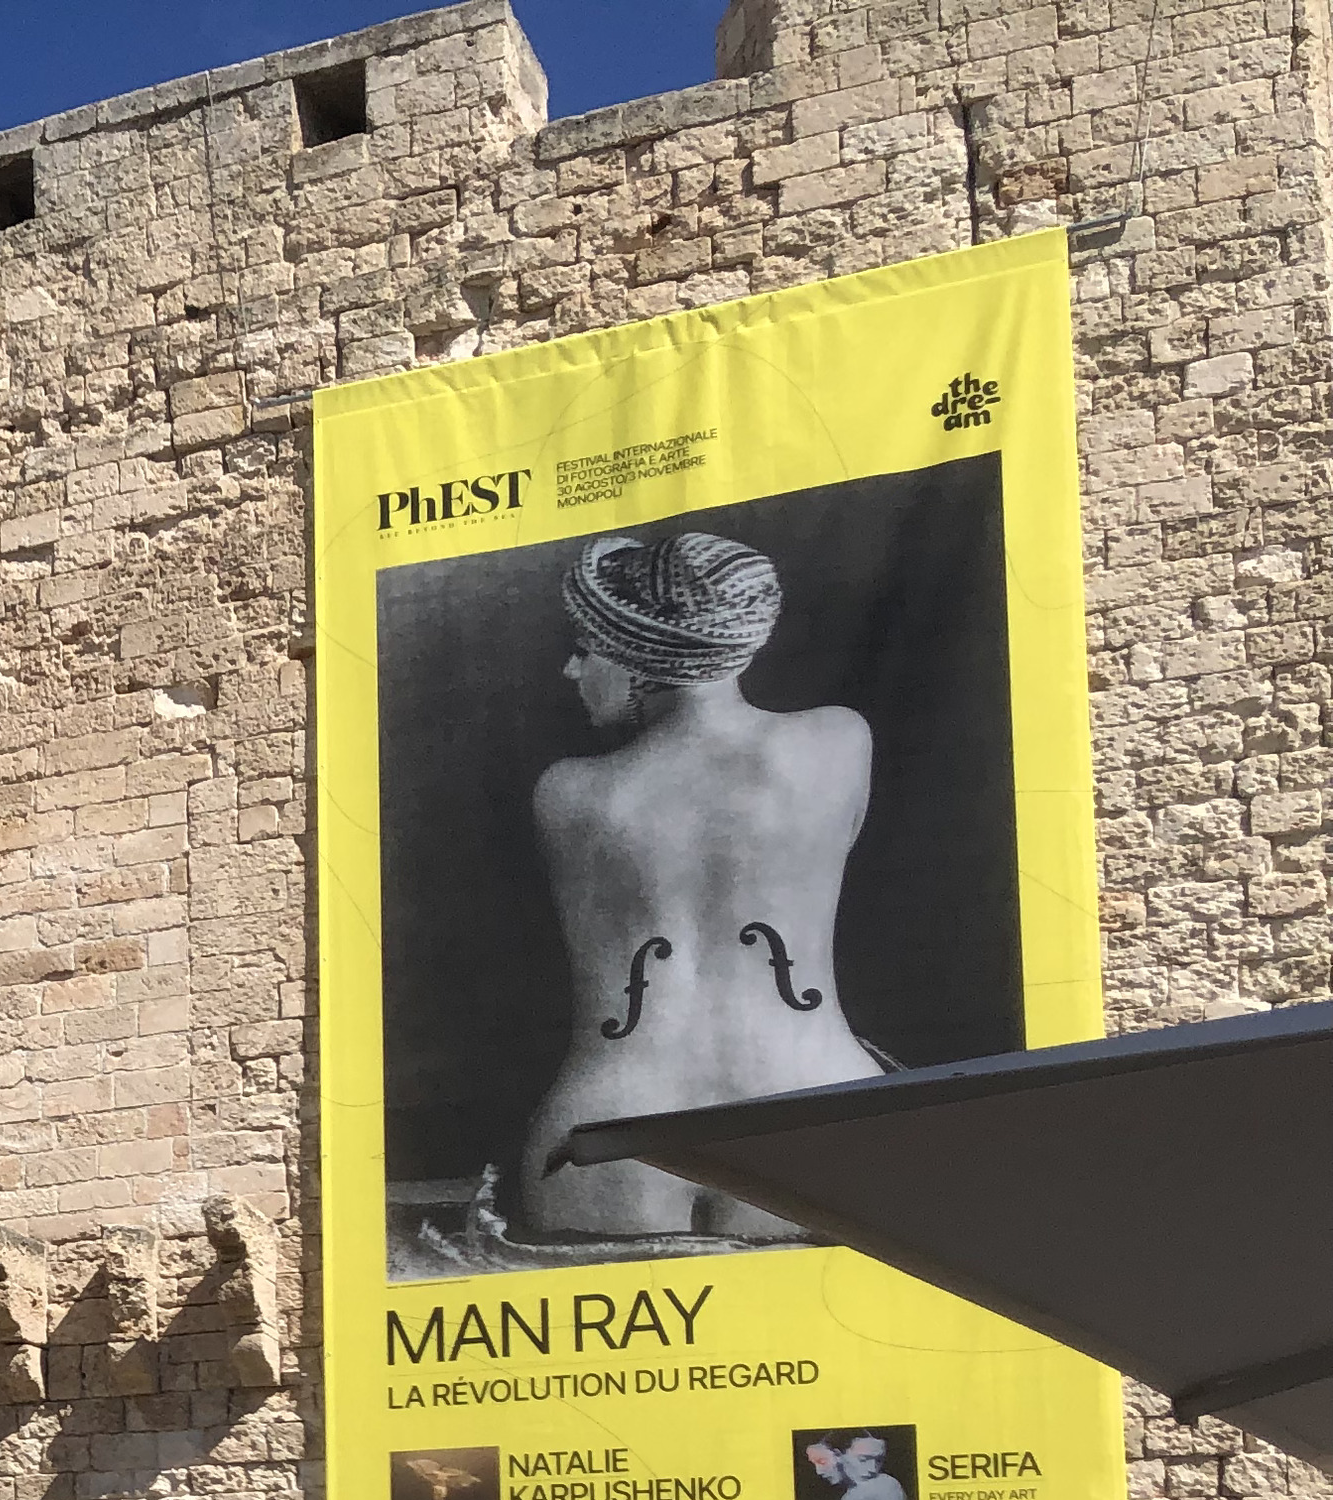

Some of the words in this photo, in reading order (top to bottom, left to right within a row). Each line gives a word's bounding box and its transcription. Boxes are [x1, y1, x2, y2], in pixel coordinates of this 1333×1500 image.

[948, 371, 999, 398] the
[943, 410, 991, 431] am
[556, 453, 610, 472] FESTIVAL
[613, 428, 718, 461] INTERNAZIONALE
[556, 474, 568, 485] DI
[571, 457, 646, 482] FOTOGRAFIA
[649, 455, 656, 465] E
[659, 446, 689, 463] ARTE
[557, 485, 572, 497] 30
[575, 472, 636, 492] AGOSTO/3
[638, 455, 706, 478] NOVEMBRE
[377, 469, 532, 531] PhEST
[557, 487, 623, 508] MONOPOLI
[386, 1298, 550, 1365] MAN
[573, 1285, 713, 1352] RAY
[388, 1384, 425, 1409] LA
[433, 1370, 627, 1407] RÉVOLUTION
[635, 1368, 679, 1394] DU
[688, 1360, 819, 1391] REGARD
[509, 1448, 629, 1478] NATALIE
[928, 1451, 1042, 1481] SERIFA
[1009, 1488, 1037, 1500] ART
